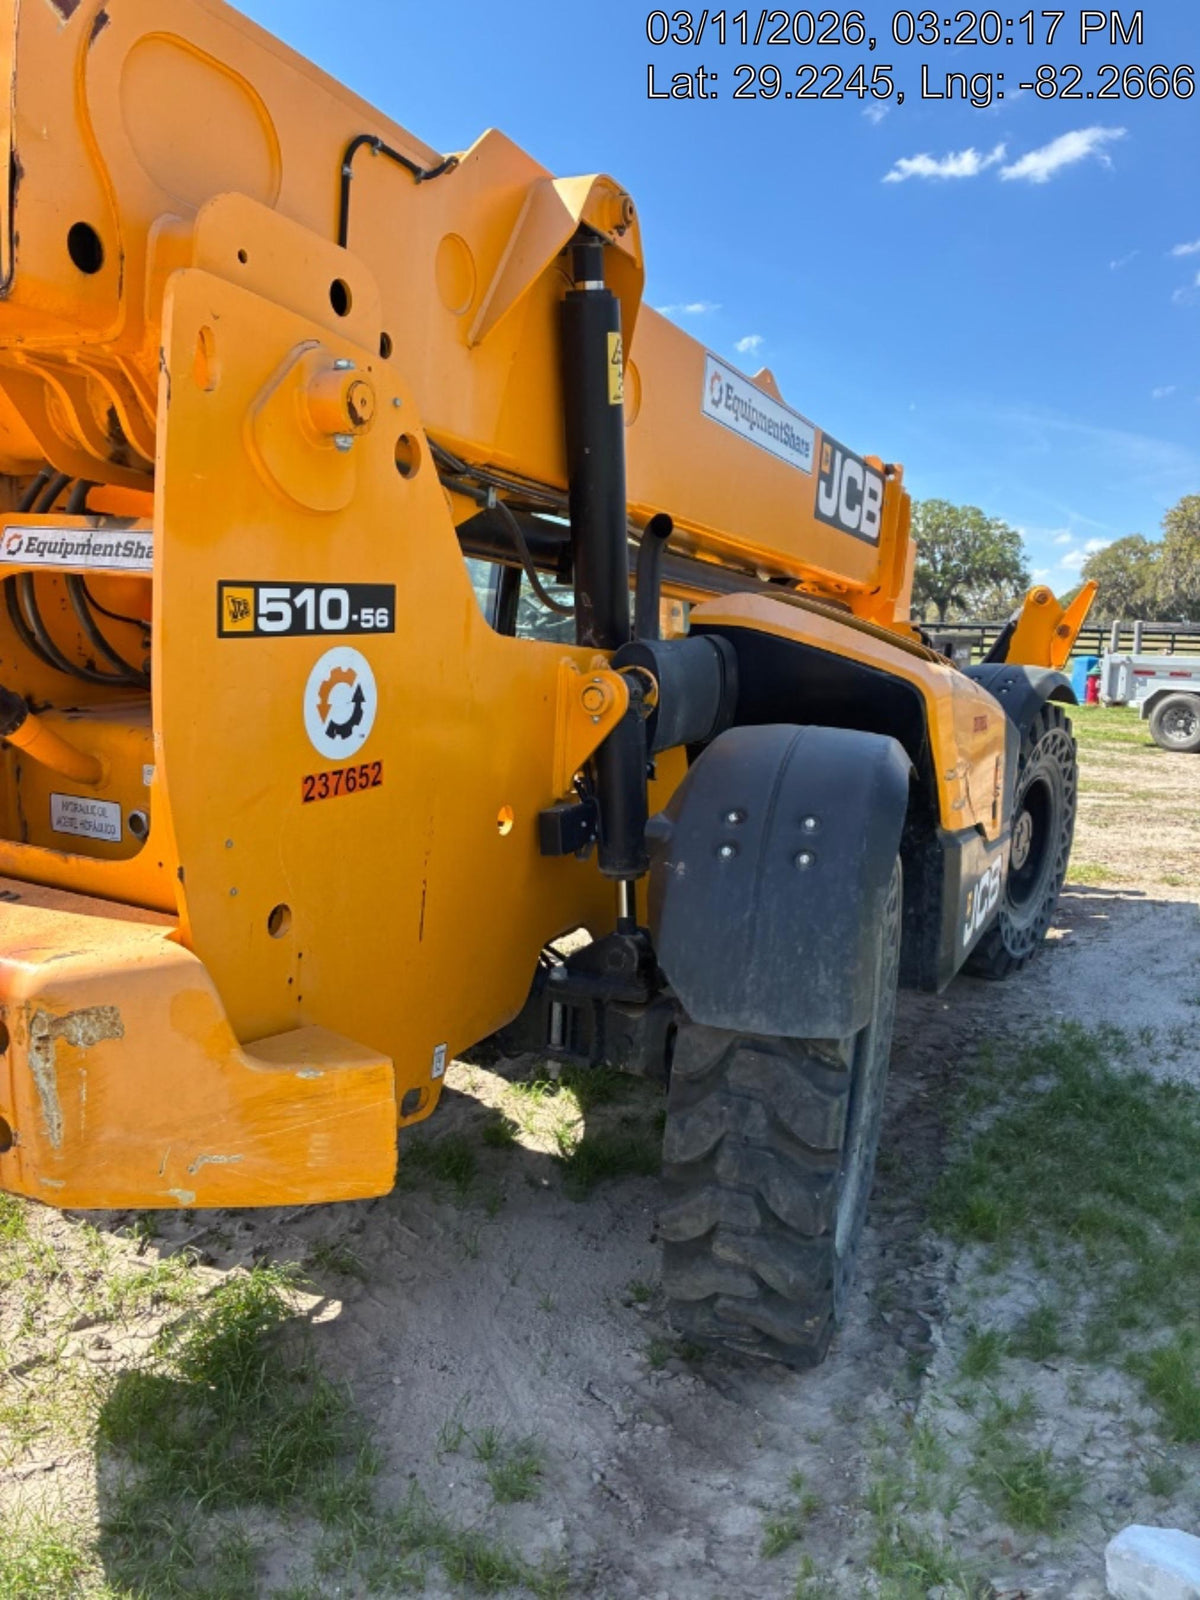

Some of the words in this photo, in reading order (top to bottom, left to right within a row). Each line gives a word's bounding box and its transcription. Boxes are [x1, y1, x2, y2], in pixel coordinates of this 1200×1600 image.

[724, 383, 810, 459] EquipmentShare
[818, 450, 883, 538] JCB
[303, 761, 382, 803] 237652
[963, 853, 1002, 947] JCB
